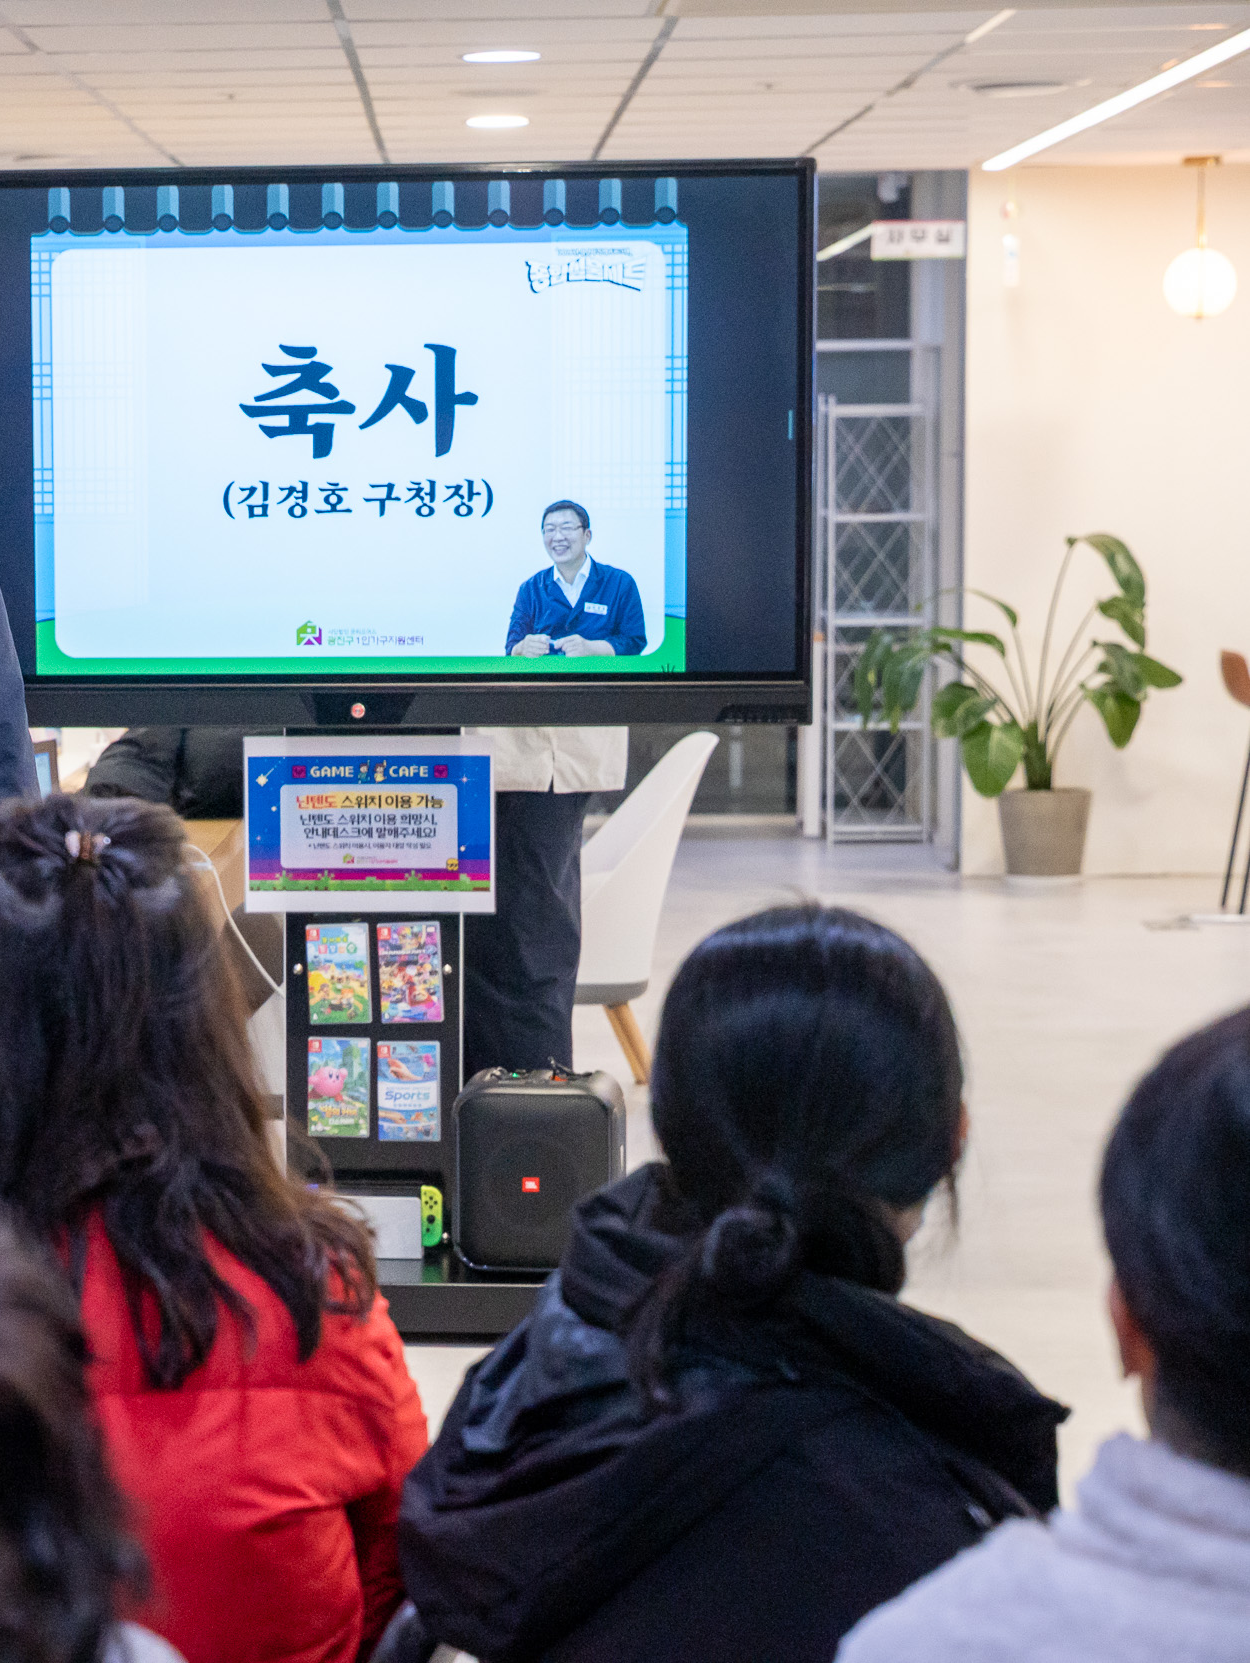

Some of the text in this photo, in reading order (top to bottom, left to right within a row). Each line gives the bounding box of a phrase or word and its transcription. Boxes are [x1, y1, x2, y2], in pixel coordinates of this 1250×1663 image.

[238, 343, 479, 460] 축사
[222, 478, 494, 520] (김경호 구청장)
[310, 766, 429, 777] GAME CAFE
[296, 795, 444, 809] 닌텐도 스위치 이용 가능
[300, 814, 335, 825] 닌텐도
[337, 814, 372, 825] 스위치
[374, 814, 397, 825] 이용
[304, 827, 437, 839] 안내데스크에 말해주세요!
[385, 1090, 431, 1102] Sports
